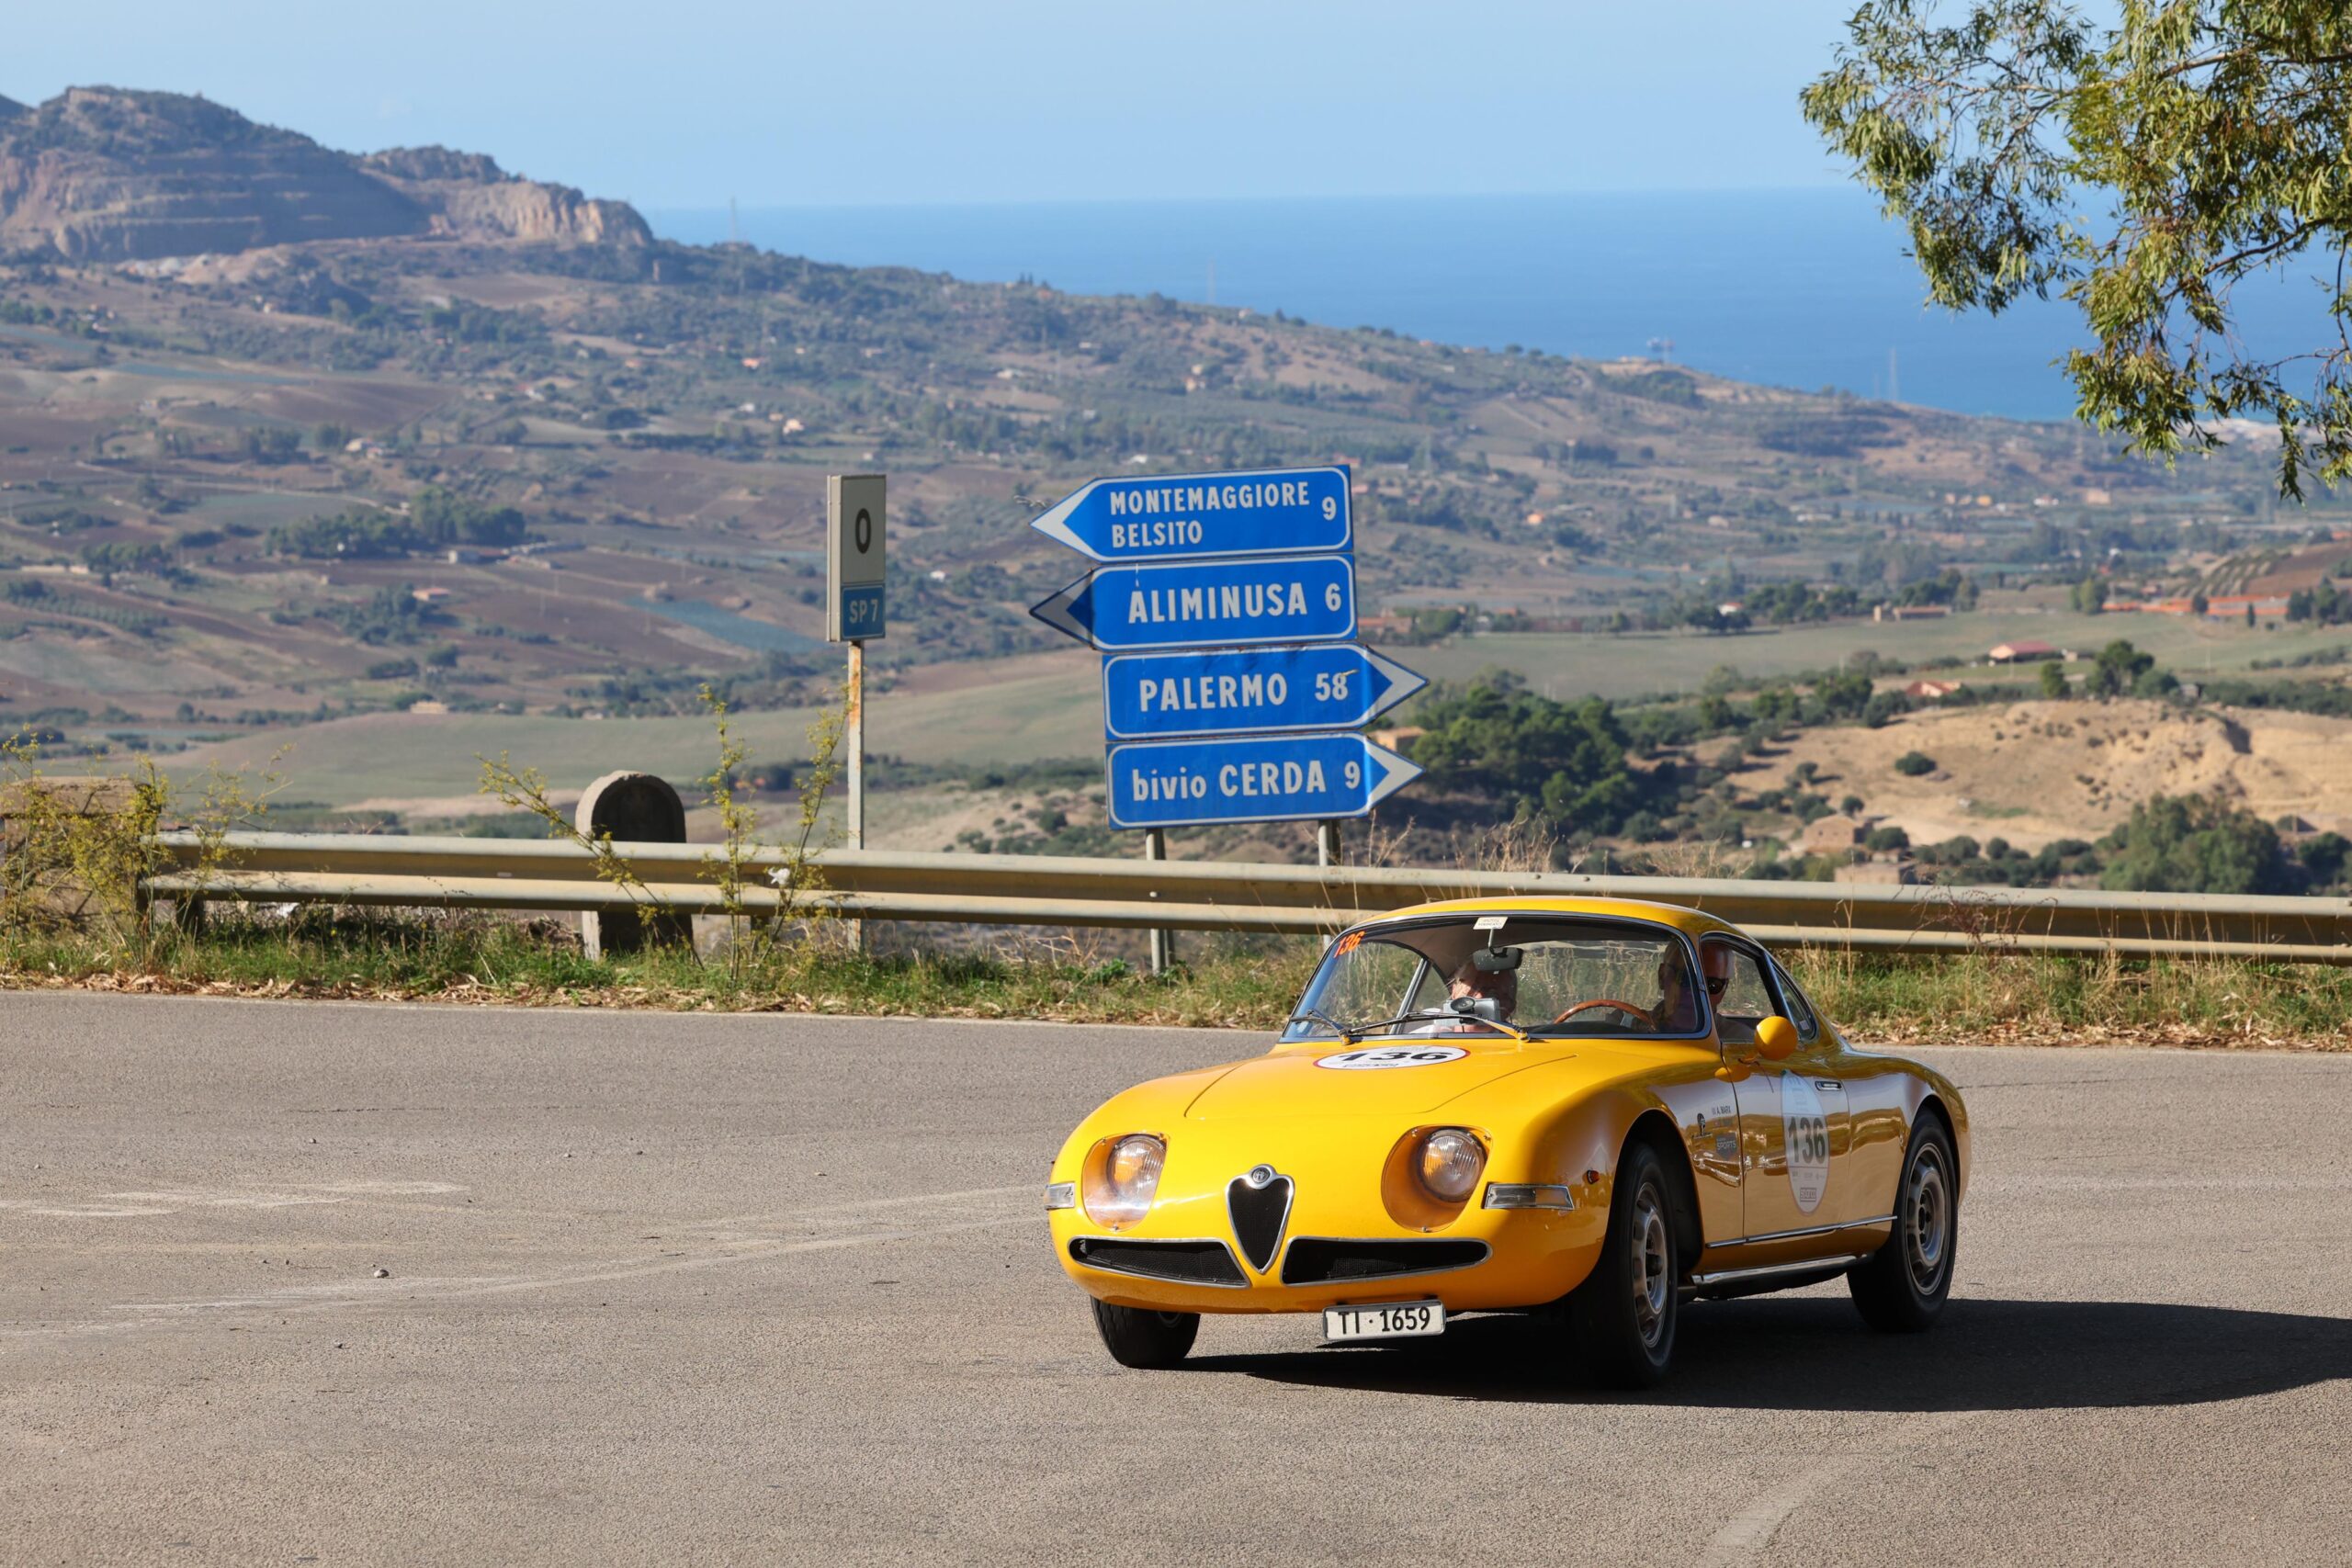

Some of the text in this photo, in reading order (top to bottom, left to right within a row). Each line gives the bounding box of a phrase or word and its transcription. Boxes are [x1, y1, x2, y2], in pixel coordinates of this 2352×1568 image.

[1110, 481, 1310, 516] MONTEMAGGIORE
[1321, 496, 1338, 522] 9
[1112, 520, 1204, 548] BELSITO
[849, 599, 879, 625] SP 7
[1128, 582, 1308, 624] ALIMINUSA
[1325, 583, 1342, 612] 6
[1139, 672, 1349, 712] PALERMO 58
[1132, 759, 1362, 802] bivio CERDA 9
[1333, 931, 1366, 958] 136
[1338, 1052, 1453, 1062] 136
[1788, 1116, 1826, 1164] 136
